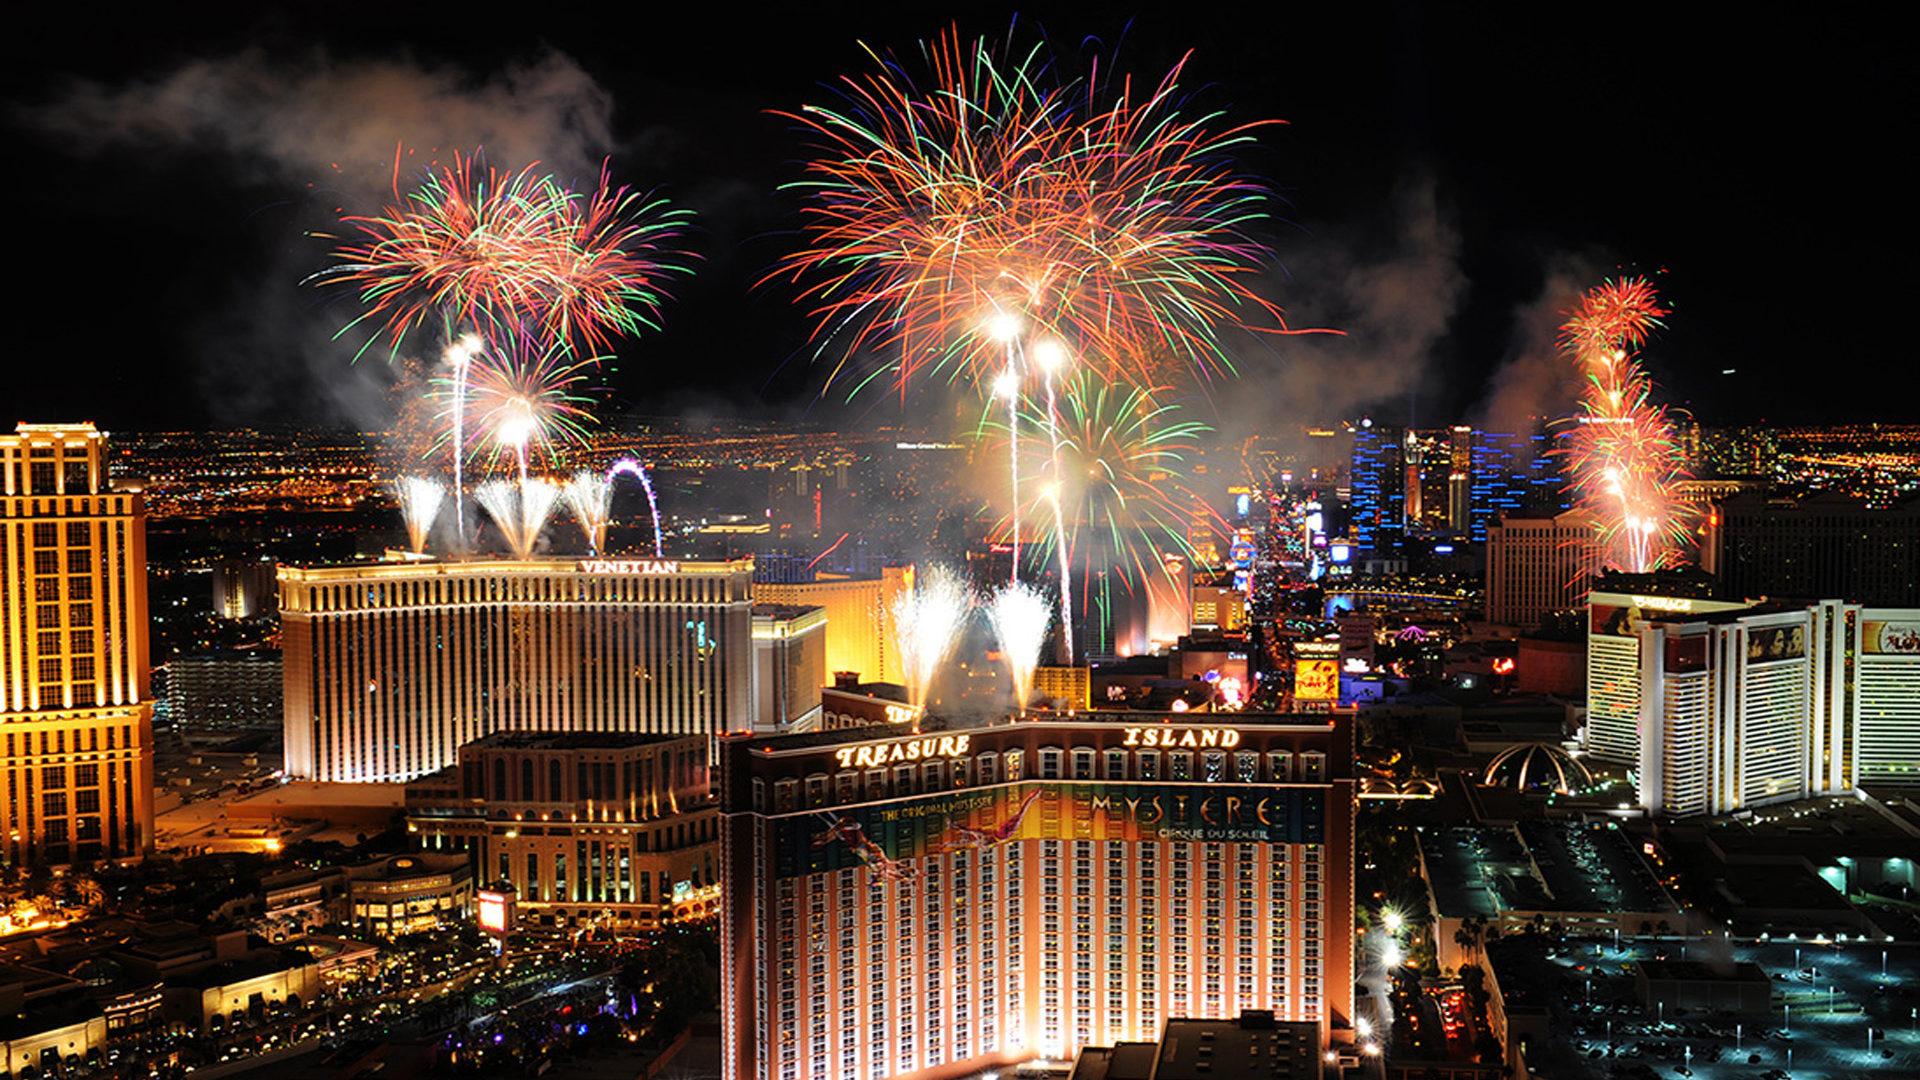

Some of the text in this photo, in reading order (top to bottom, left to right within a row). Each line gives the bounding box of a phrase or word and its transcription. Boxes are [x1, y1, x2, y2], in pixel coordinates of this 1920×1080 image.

[580, 560, 679, 574] VENETIAN
[835, 727, 1241, 768] TREASURE ISLAND
[880, 809, 900, 821] THE
[1158, 828, 1271, 841] CIRQUE DU SOLEIL
